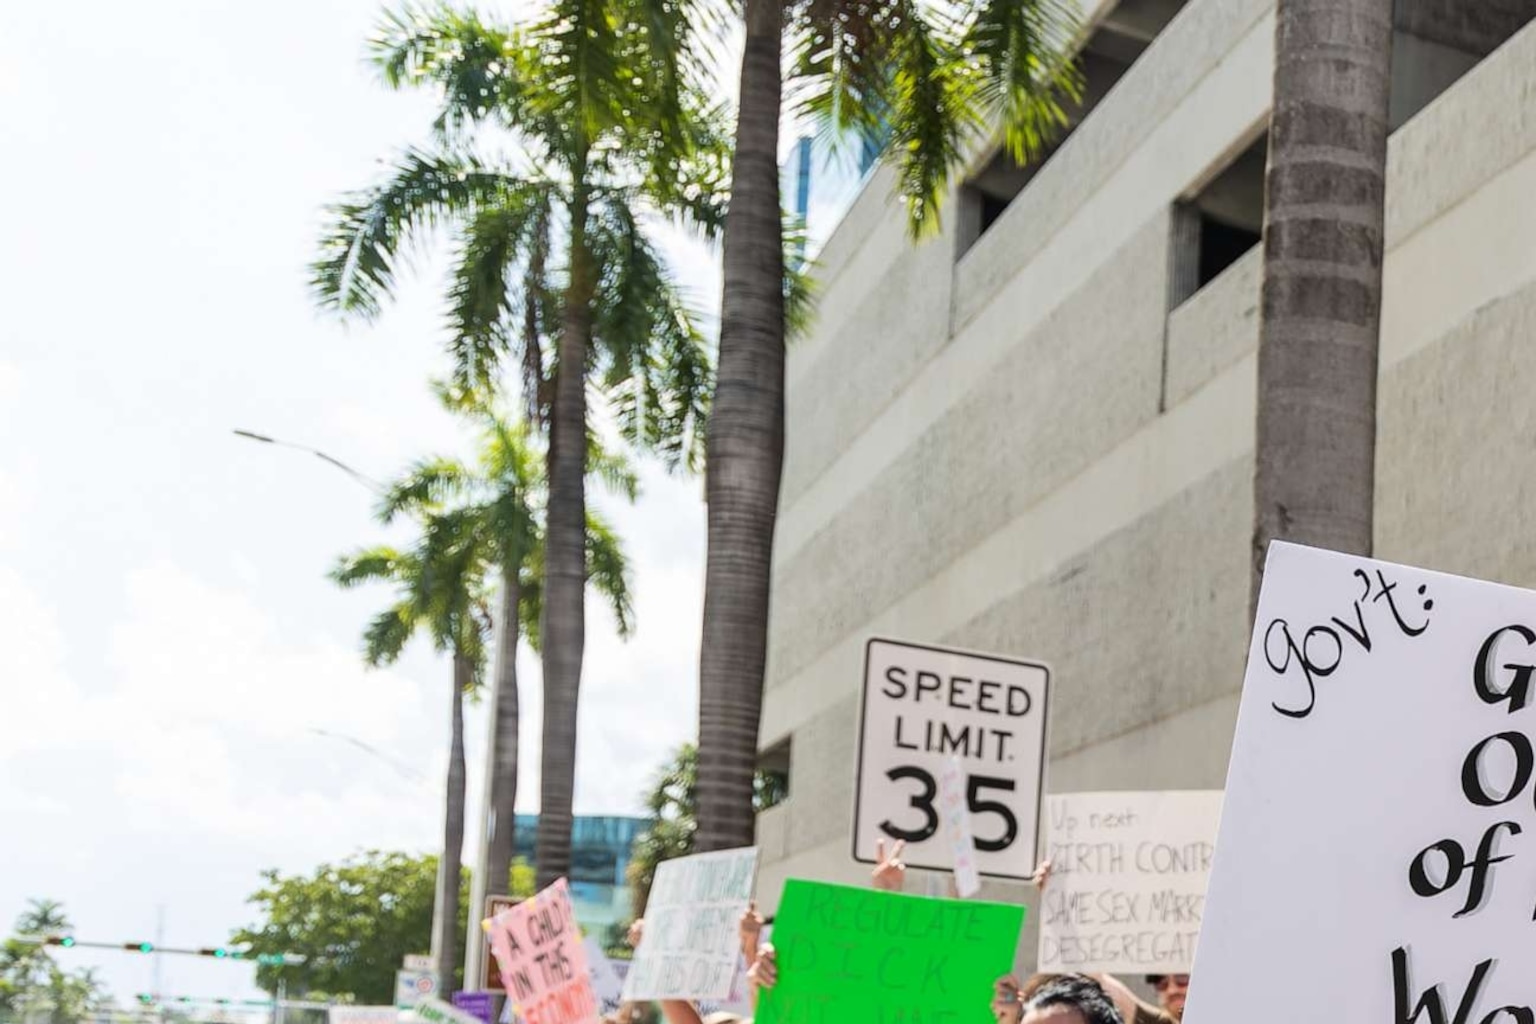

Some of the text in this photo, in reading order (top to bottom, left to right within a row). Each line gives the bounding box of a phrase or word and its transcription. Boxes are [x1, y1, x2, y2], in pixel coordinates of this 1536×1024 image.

[881, 665, 1033, 718] SPEED
[893, 714, 1014, 763] LIMIT
[878, 764, 1019, 854] 35
[1407, 820, 1523, 920] of
[806, 884, 991, 942] REGULATE
[1099, 888, 1140, 925] SEX
